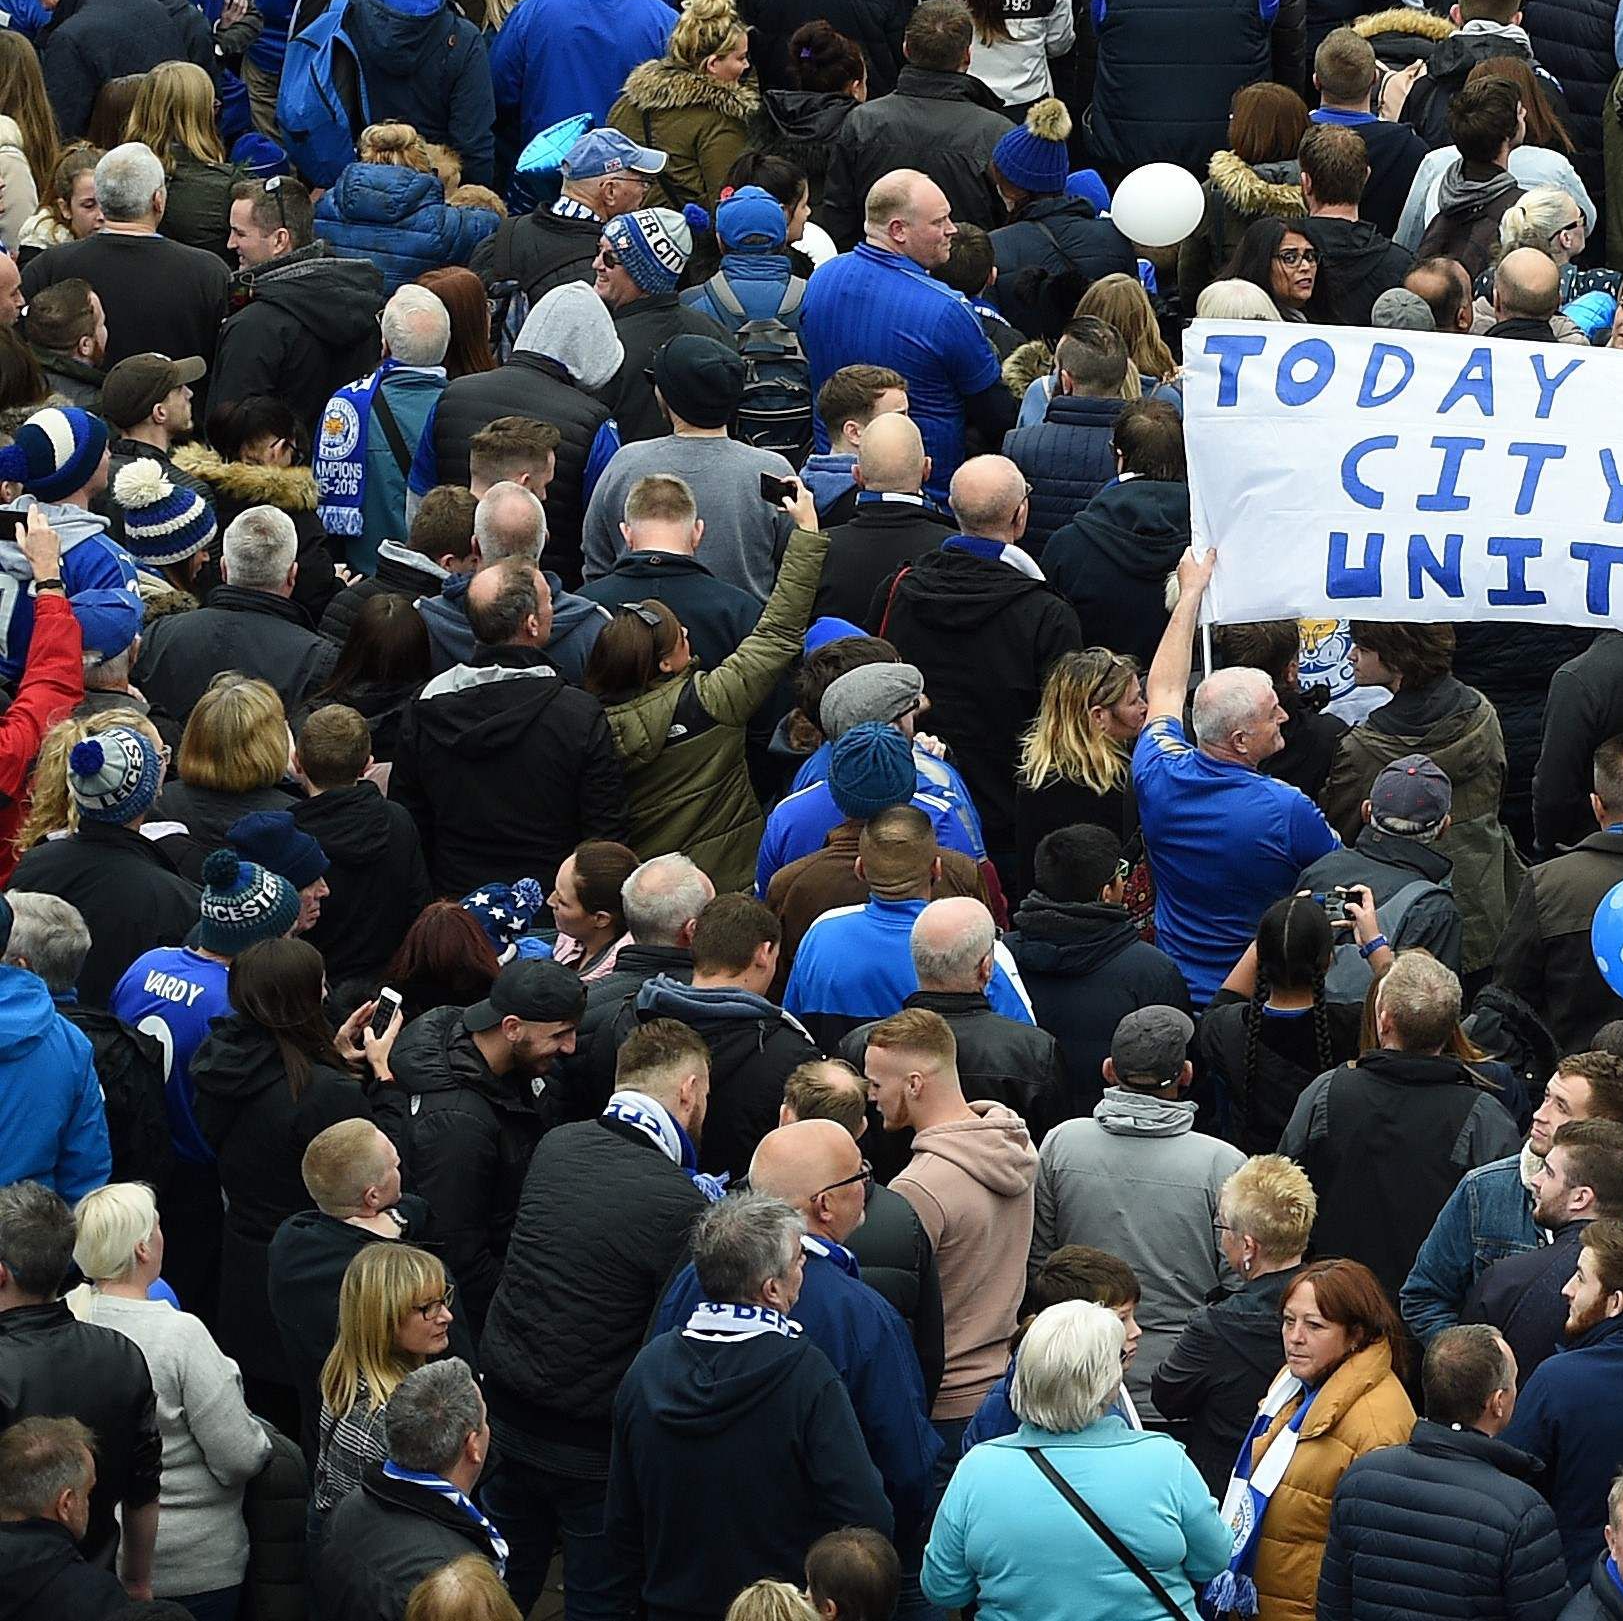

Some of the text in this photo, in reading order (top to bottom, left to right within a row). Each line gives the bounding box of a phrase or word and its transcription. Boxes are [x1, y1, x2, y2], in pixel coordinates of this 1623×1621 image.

[654, 232, 687, 274] CITY
[1203, 334, 1584, 419] TODAY
[200, 869, 278, 923] EICESTER
[143, 969, 206, 1008] VARDY
